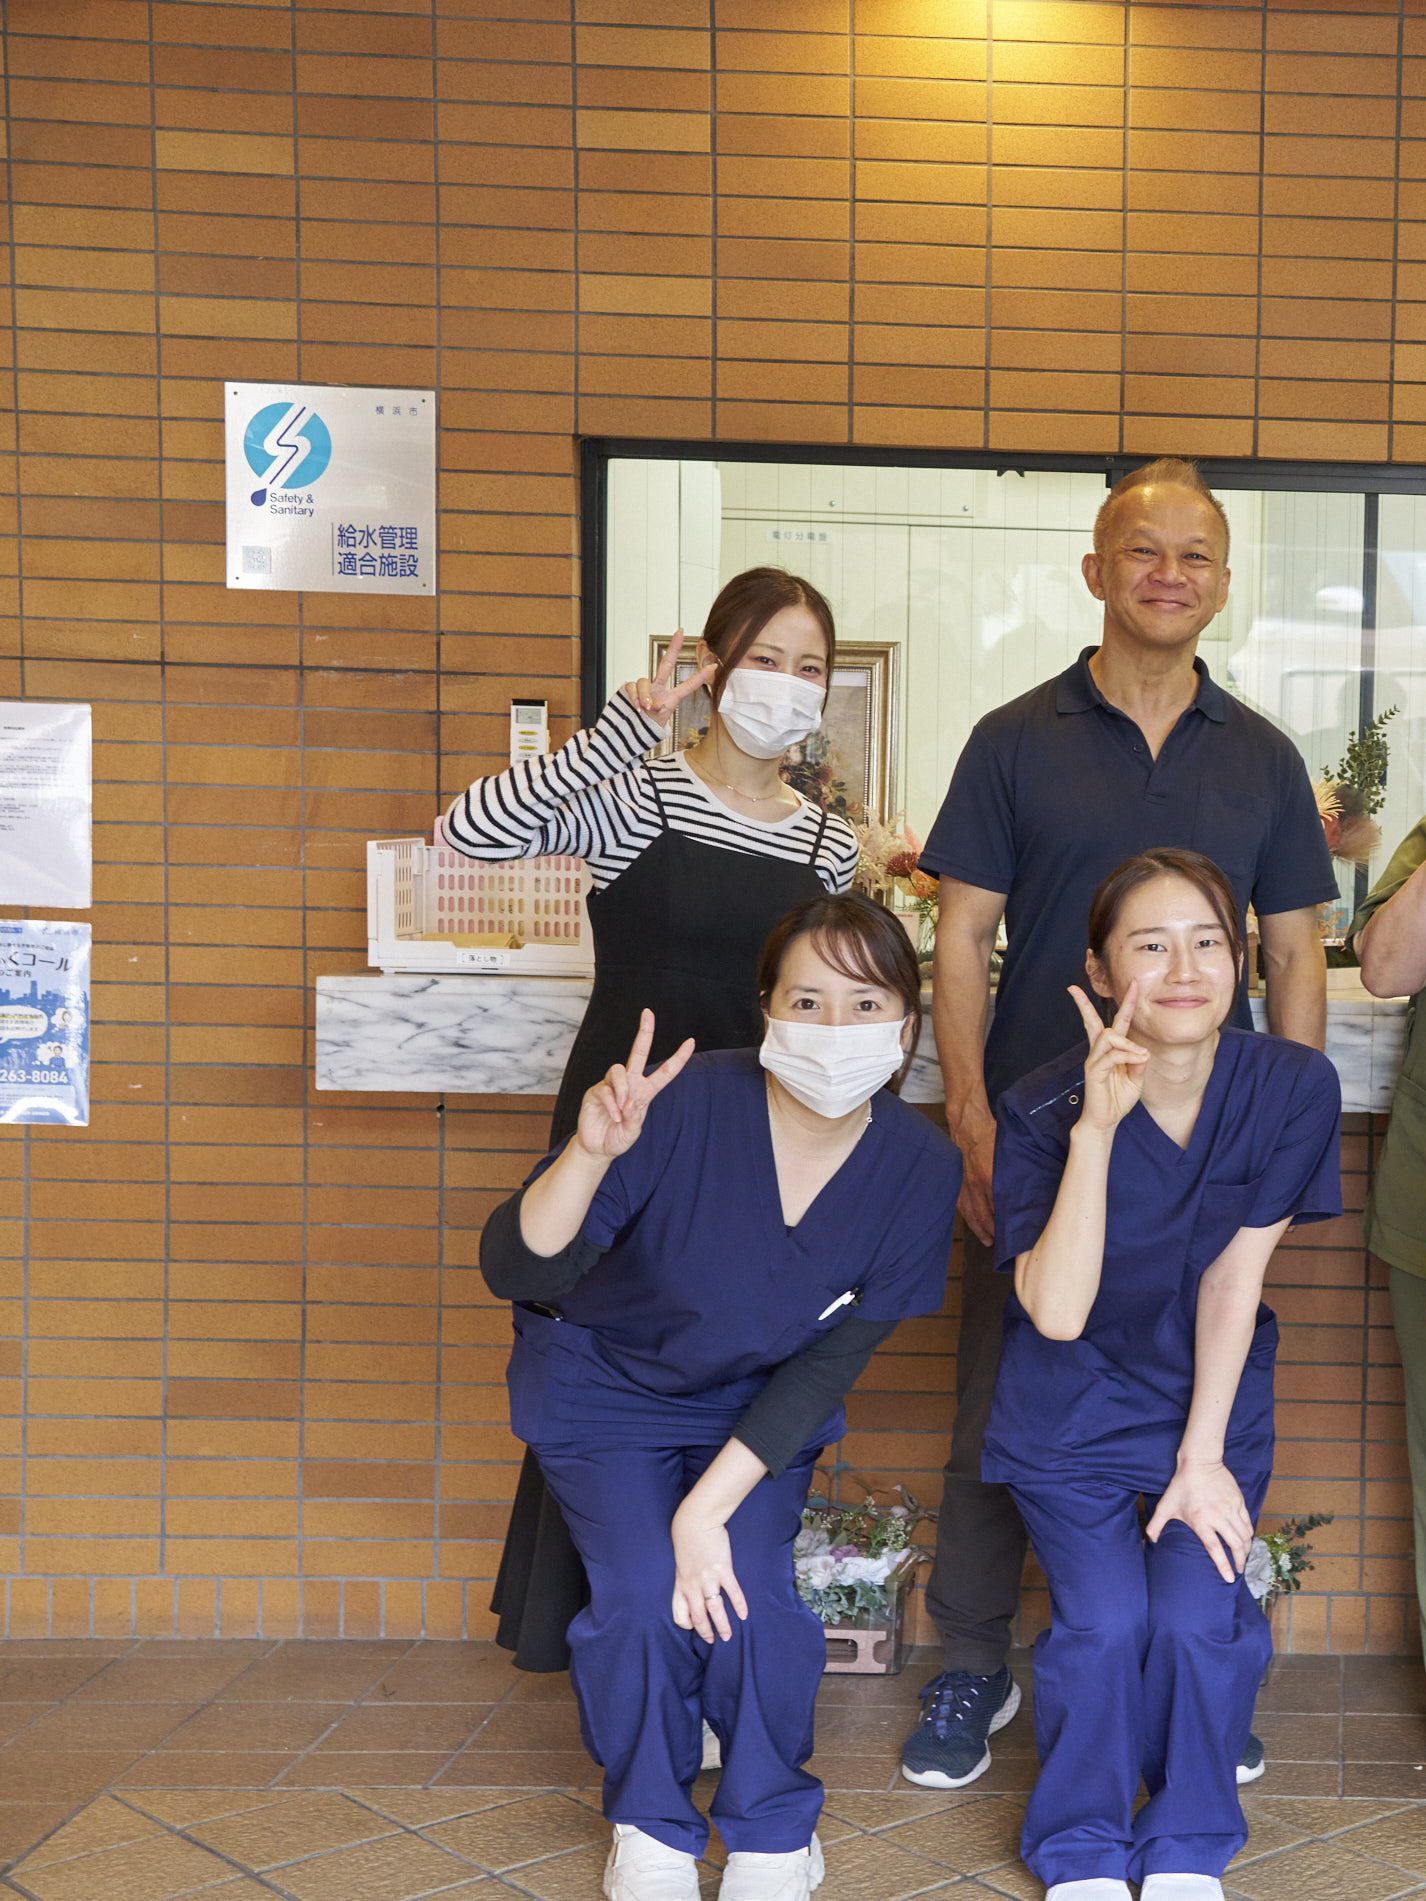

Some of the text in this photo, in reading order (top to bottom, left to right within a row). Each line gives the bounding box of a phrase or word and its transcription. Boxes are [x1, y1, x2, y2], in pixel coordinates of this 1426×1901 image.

[375, 405, 418, 417] 横浜市
[270, 493, 314, 505] Safety &
[270, 504, 314, 517] Sanitary
[337, 523, 418, 551] 給水管理
[337, 552, 419, 578] 適合施設
